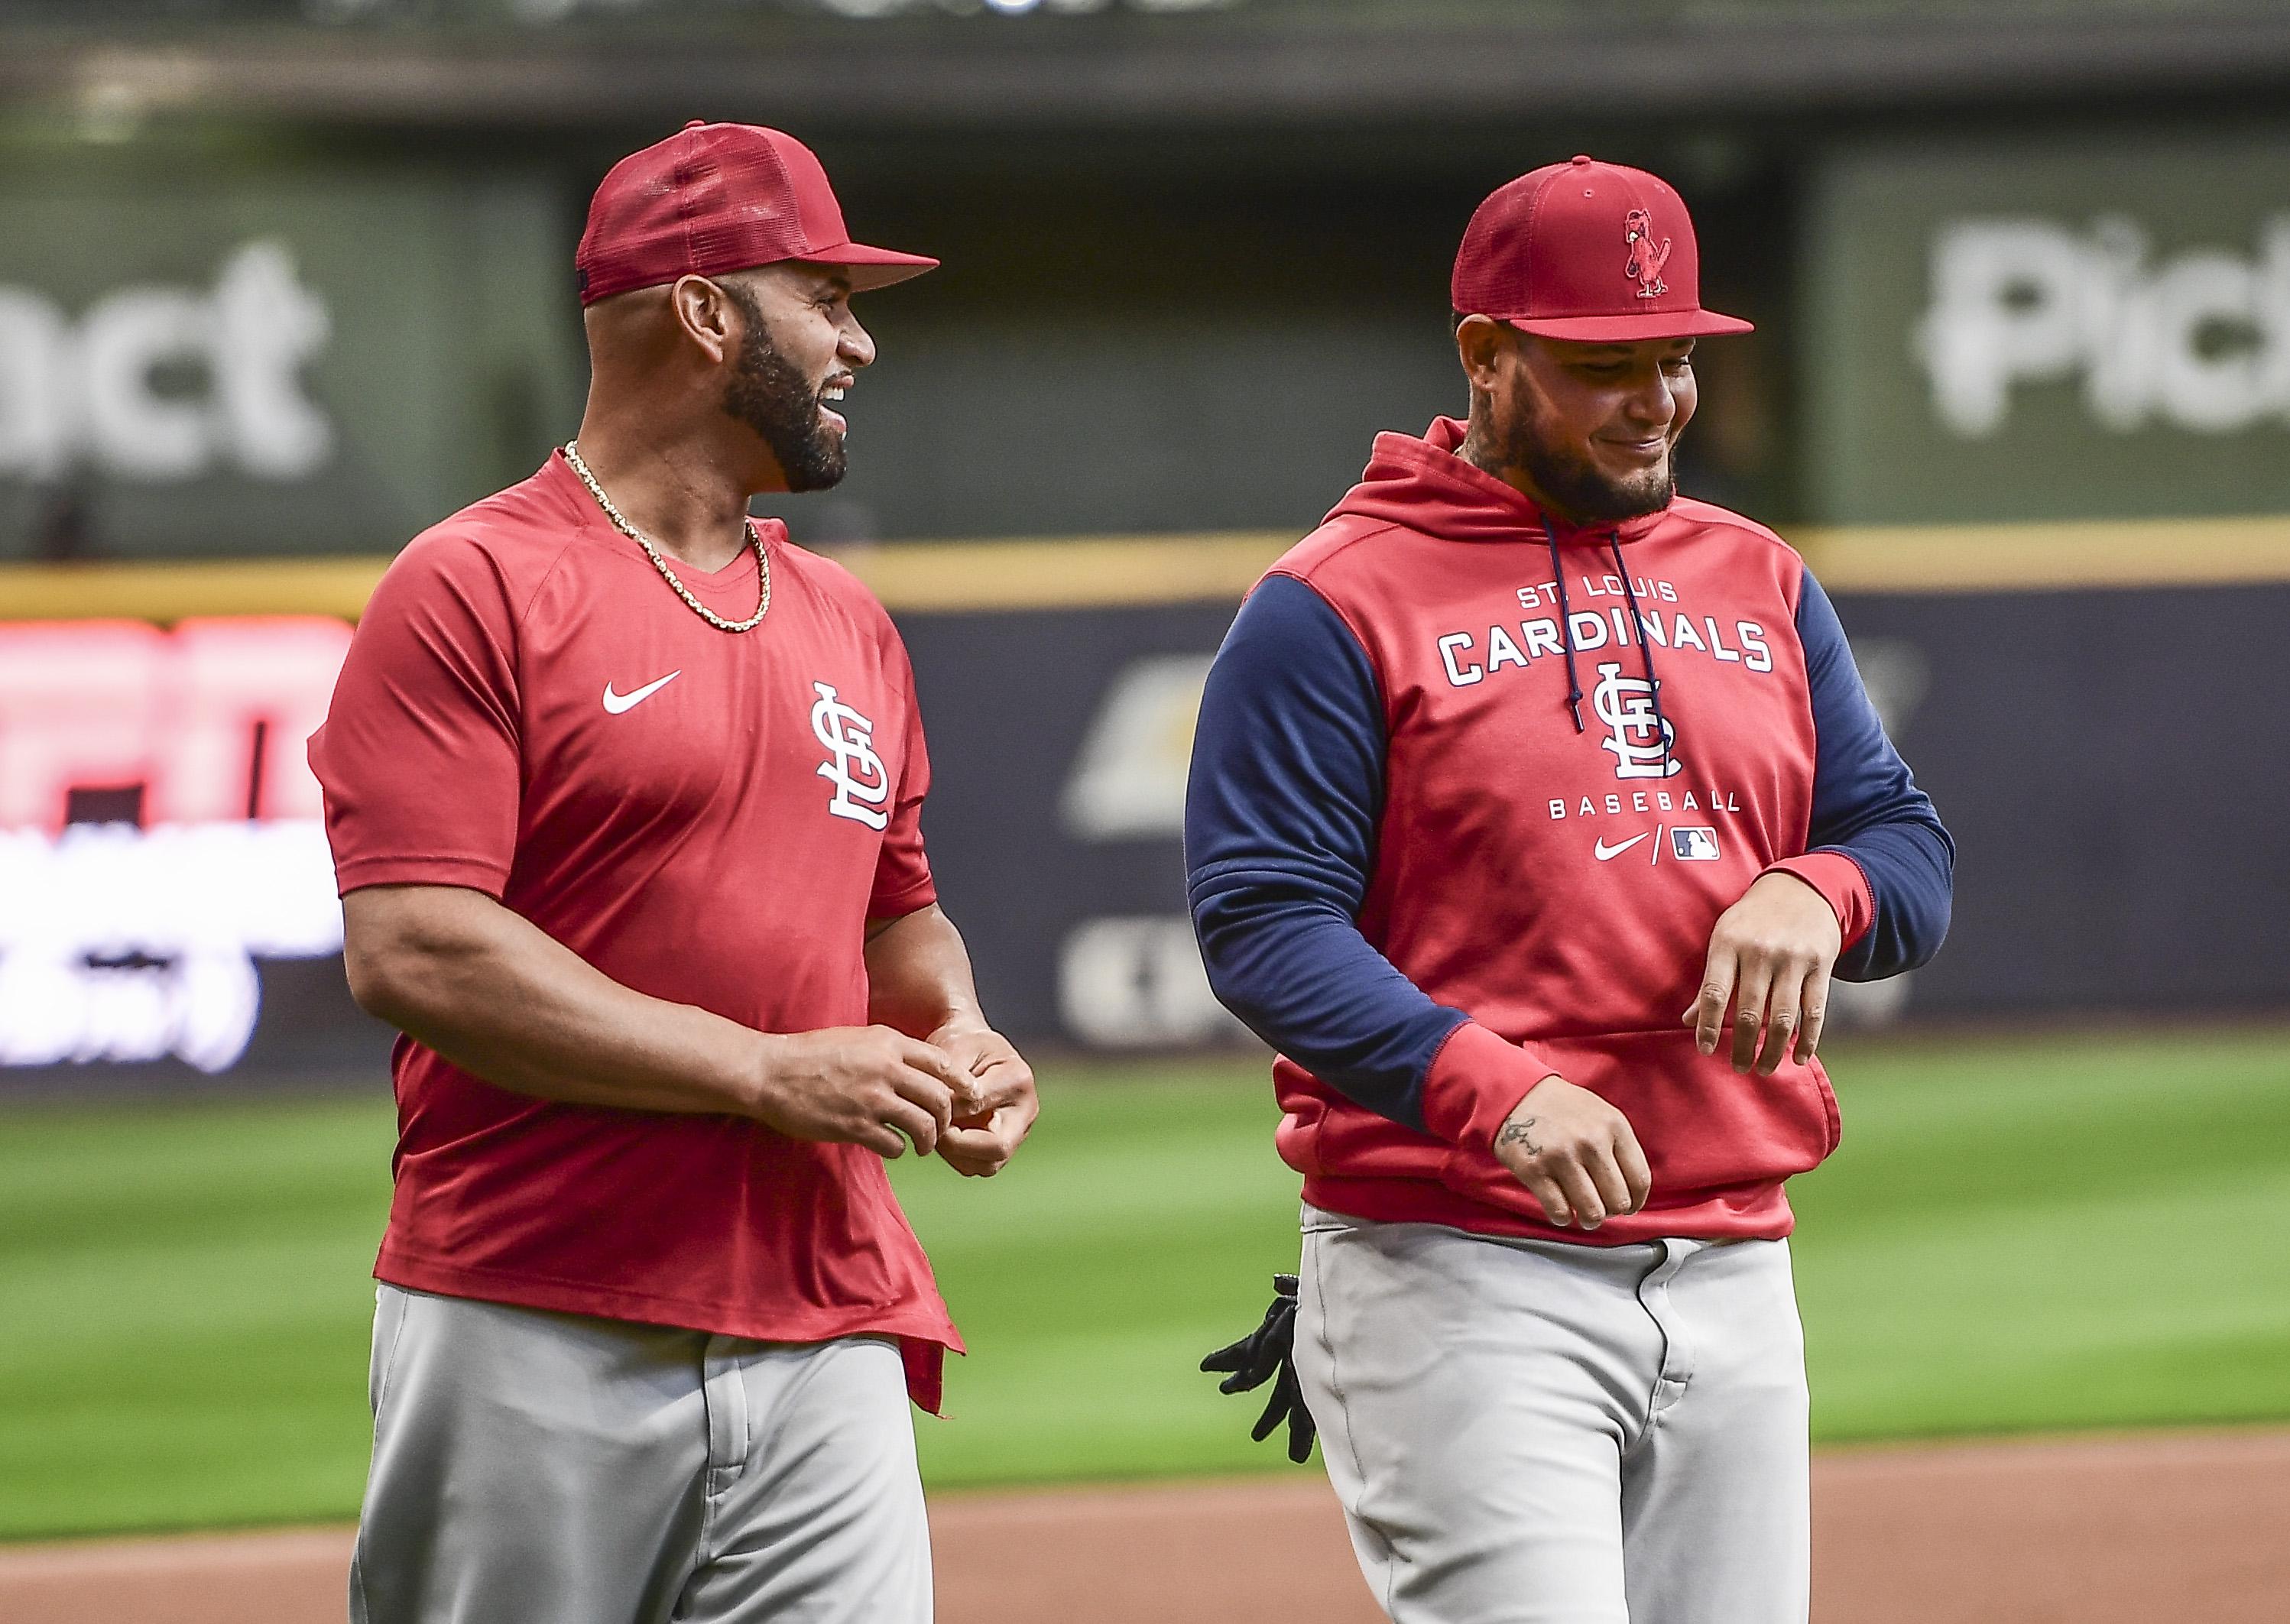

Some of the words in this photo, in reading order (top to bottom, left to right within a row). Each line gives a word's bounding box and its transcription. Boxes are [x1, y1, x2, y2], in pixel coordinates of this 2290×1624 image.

[1917, 220, 2290, 433] Pic
[1581, 575, 1679, 603] LOUIS
[1438, 608, 1773, 686] CARDINALS
[1549, 789, 1740, 819] BASEBALL
